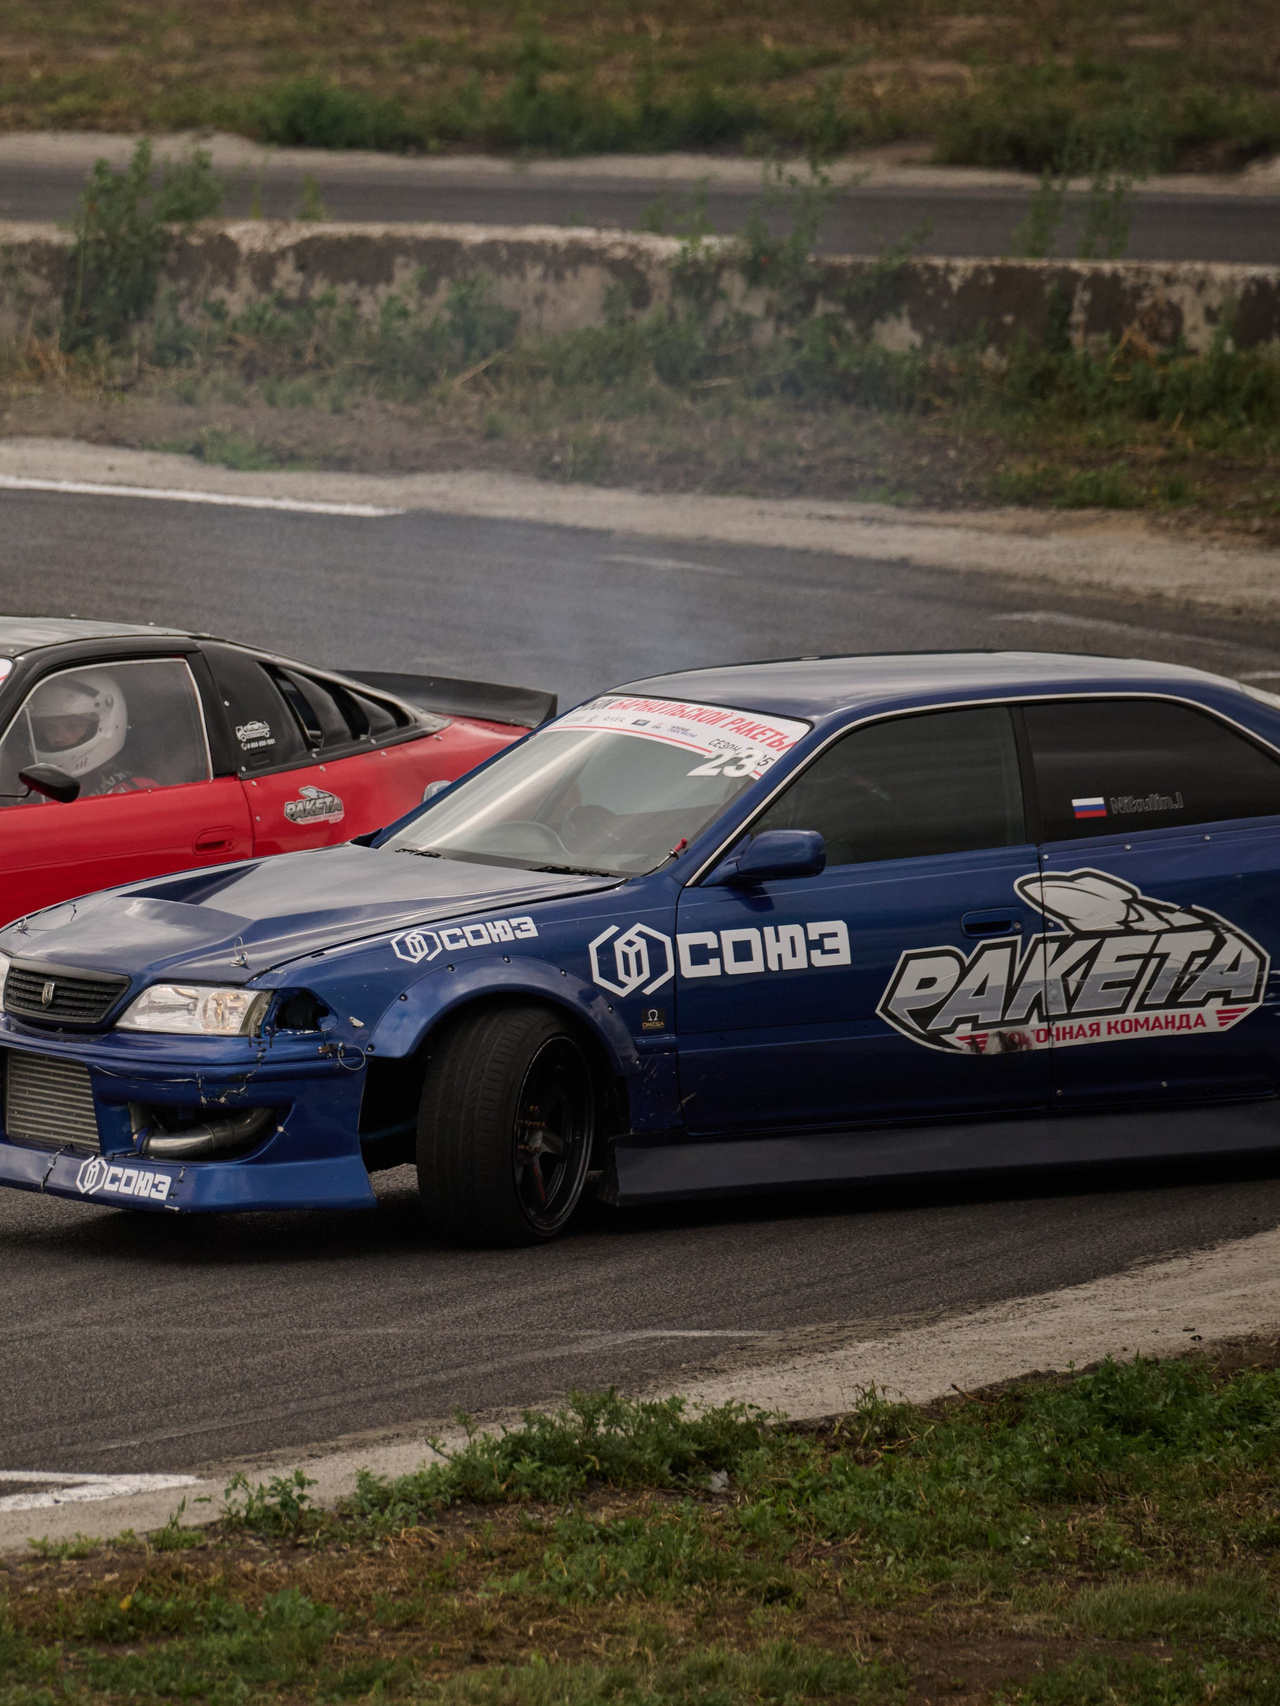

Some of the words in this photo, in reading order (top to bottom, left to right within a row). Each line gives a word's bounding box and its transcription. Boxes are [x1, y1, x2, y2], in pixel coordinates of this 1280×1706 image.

[607, 697, 736, 729] БАРНАУЛЬСКОЙ
[727, 717, 799, 752] РАКЕТЫ
[686, 747, 766, 778] 23
[286, 796, 343, 820] РАКЕТА
[438, 916, 539, 950] СОЮЗ
[676, 920, 852, 978] СОЮЗ
[886, 930, 1260, 1031] РАКЕТА
[1106, 1012, 1207, 1035] КОМАНДА
[104, 1165, 172, 1201] СОЮЗ
